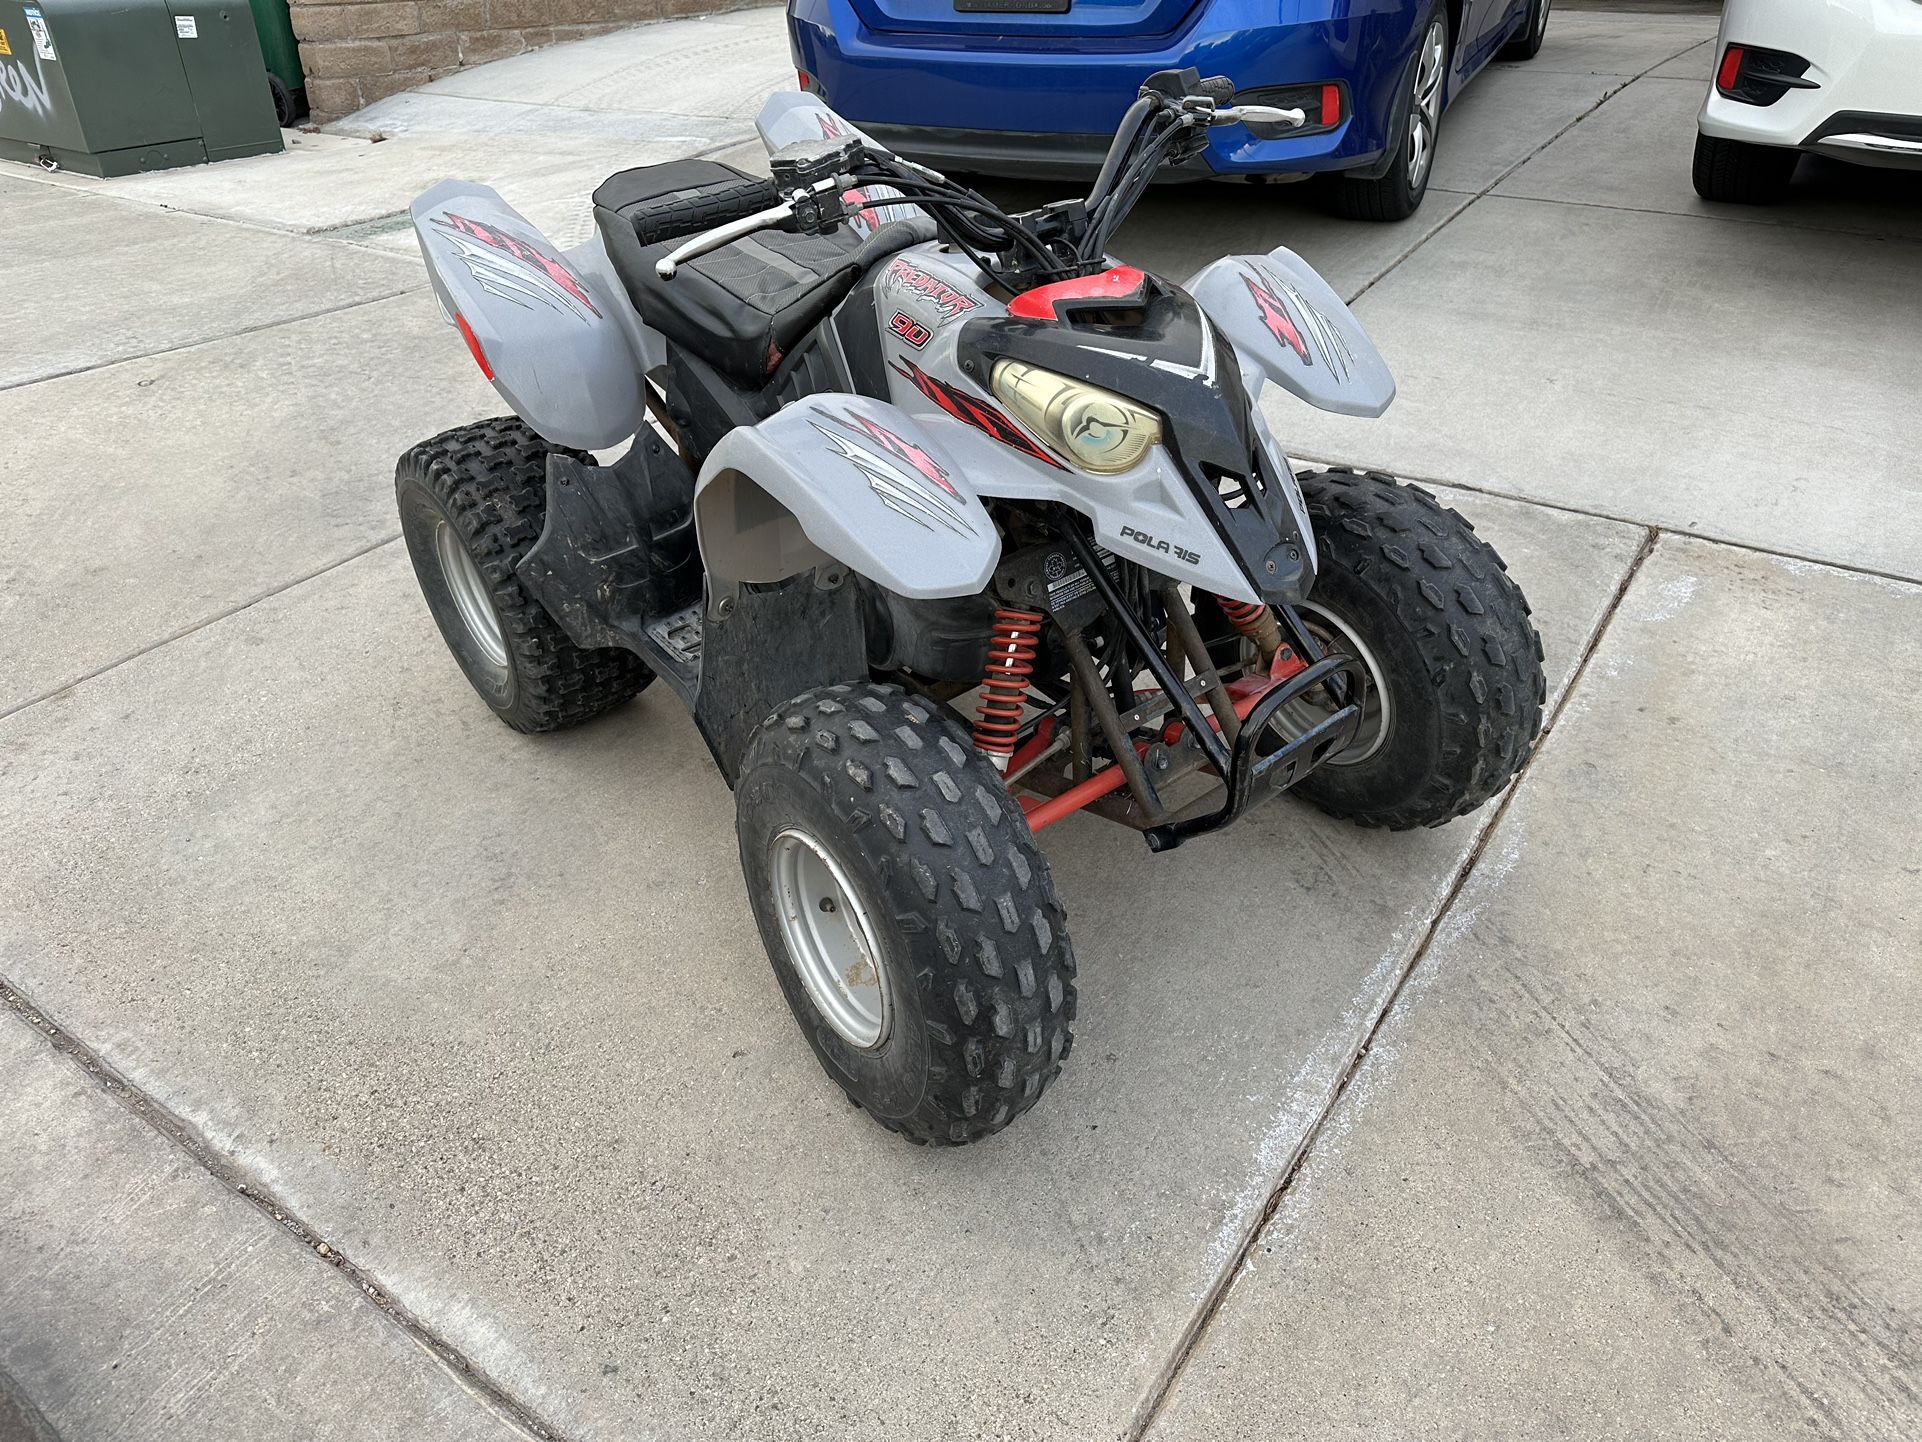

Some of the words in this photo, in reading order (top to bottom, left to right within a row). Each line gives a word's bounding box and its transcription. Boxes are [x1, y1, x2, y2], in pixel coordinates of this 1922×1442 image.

[883, 258, 980, 322] PREDATOR
[891, 311, 932, 348] 90
[1120, 525, 1202, 565] POLARIS
